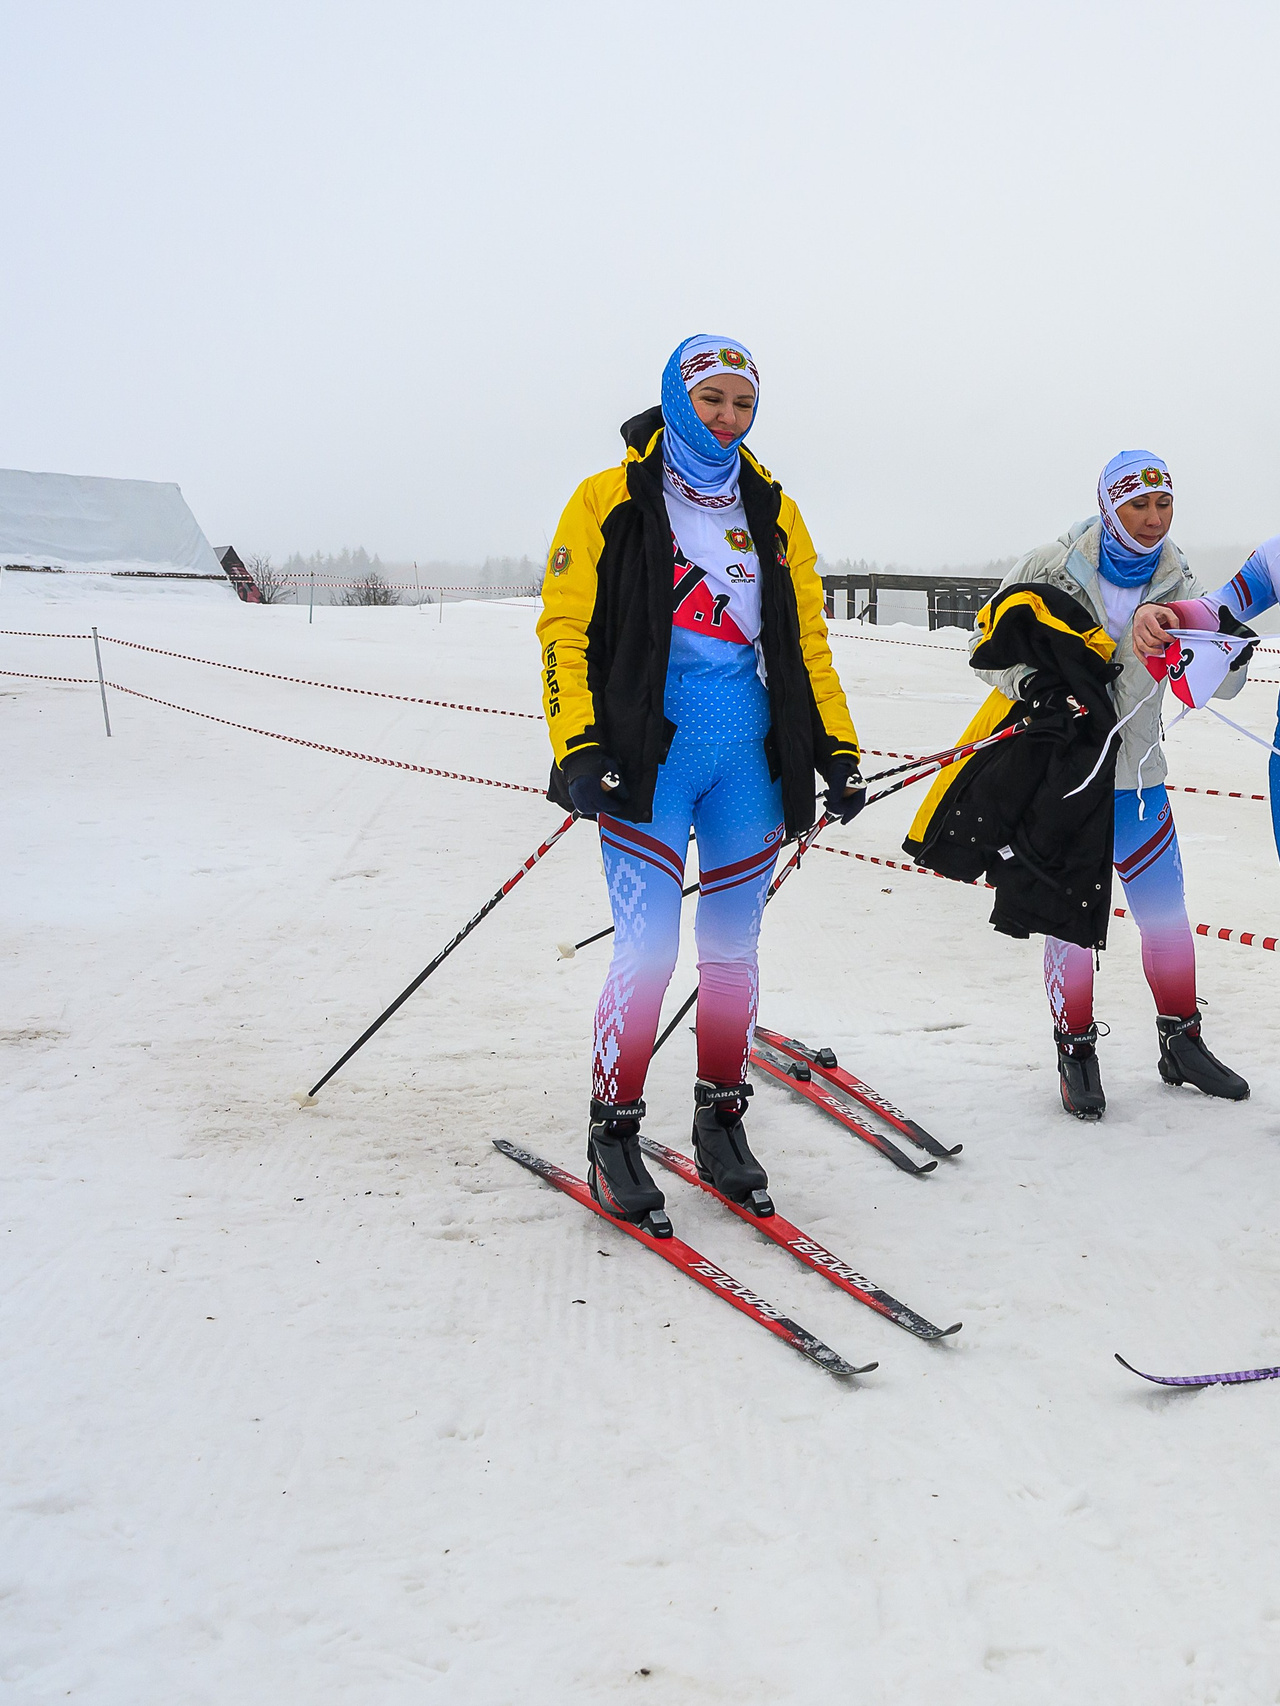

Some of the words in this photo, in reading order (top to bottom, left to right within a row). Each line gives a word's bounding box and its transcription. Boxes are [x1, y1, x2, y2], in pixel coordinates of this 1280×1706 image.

[1073, 1034, 1096, 1042] MARA
[706, 1089, 741, 1099] MARAX
[616, 1108, 644, 1116] MARA
[787, 1237, 881, 1292] ТЕЛЕХАНЫ
[688, 1260, 789, 1320] ТЕЛЕХАНЫ
